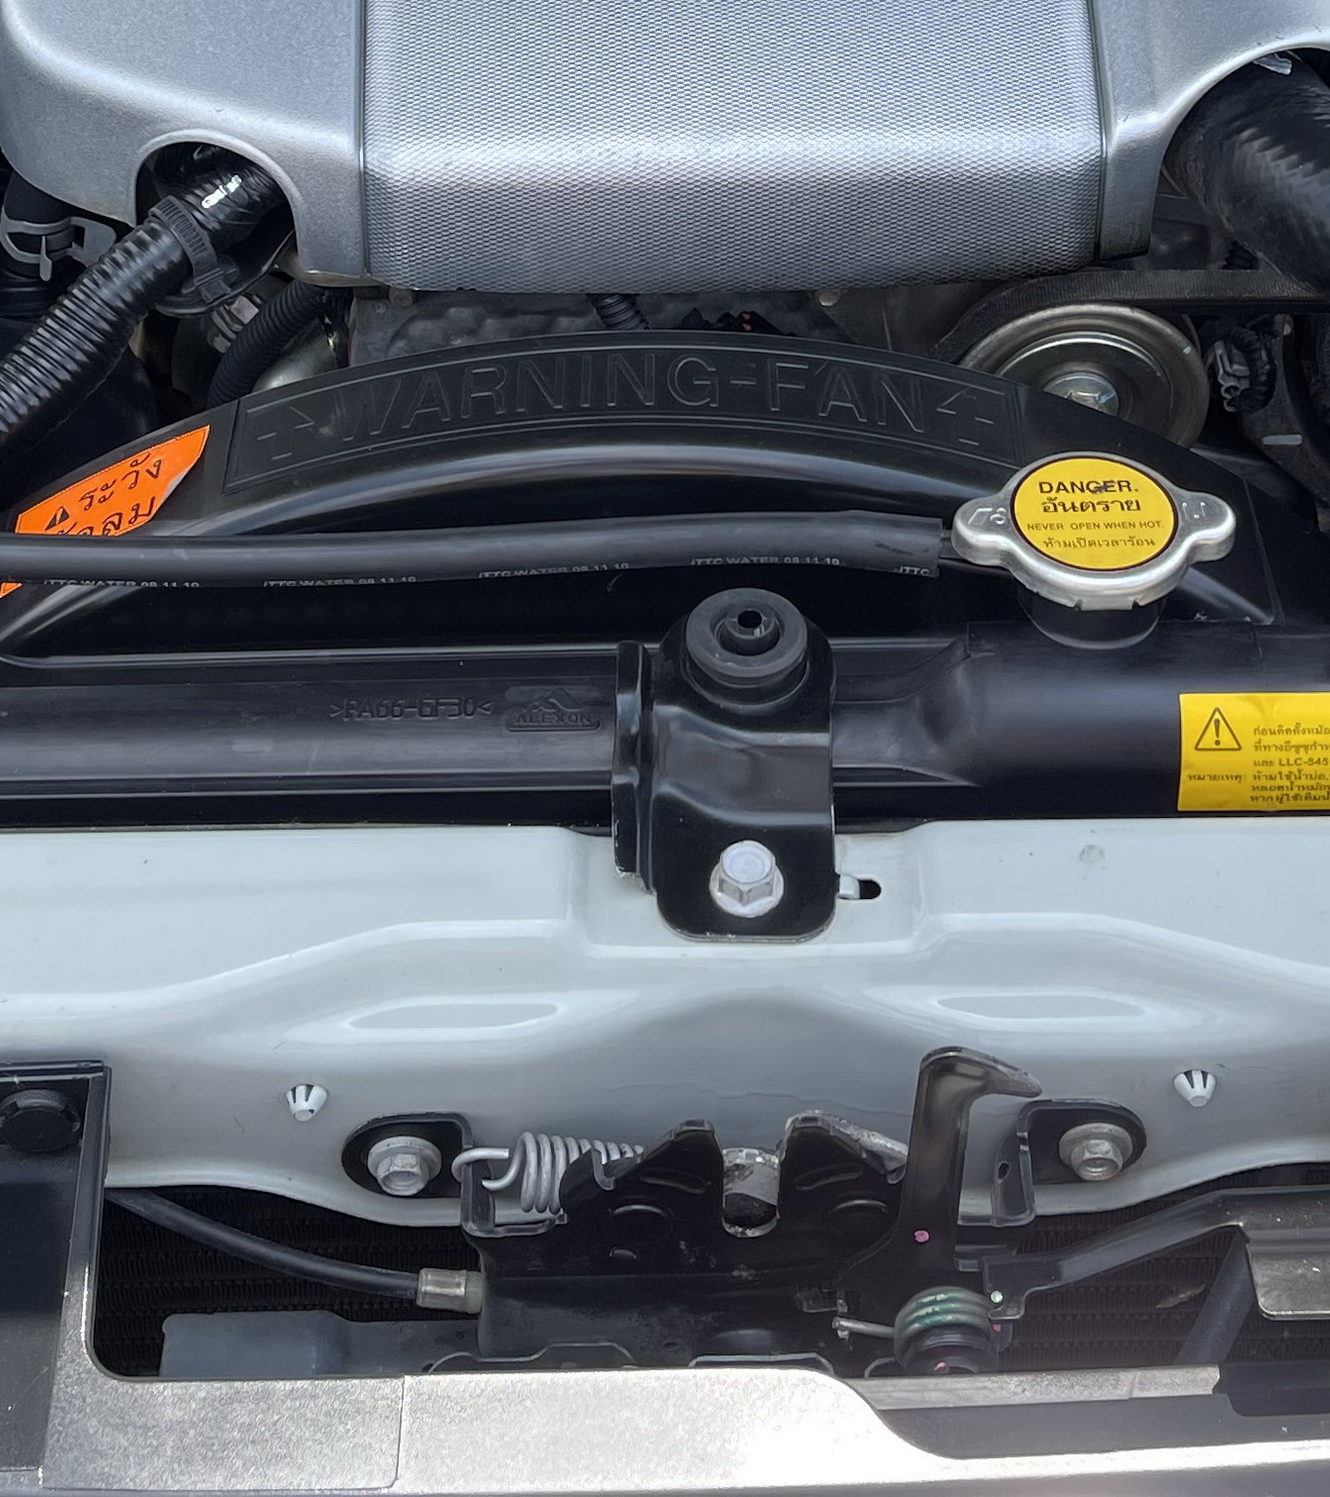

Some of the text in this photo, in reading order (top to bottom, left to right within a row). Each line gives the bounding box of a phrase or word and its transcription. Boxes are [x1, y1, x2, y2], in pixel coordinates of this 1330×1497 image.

[77, 450, 163, 512] ระวัง
[1041, 496, 1142, 514] อันตราย
[1026, 522, 1065, 531] NEVER
[1070, 521, 1101, 531] OPEN
[1102, 520, 1137, 530] WHEN
[725, 555, 780, 564] WATER
[513, 566, 569, 576] WATER
[79, 579, 137, 588] WATER
[299, 578, 356, 587] WATER
[514, 711, 593, 726] ALEXON
